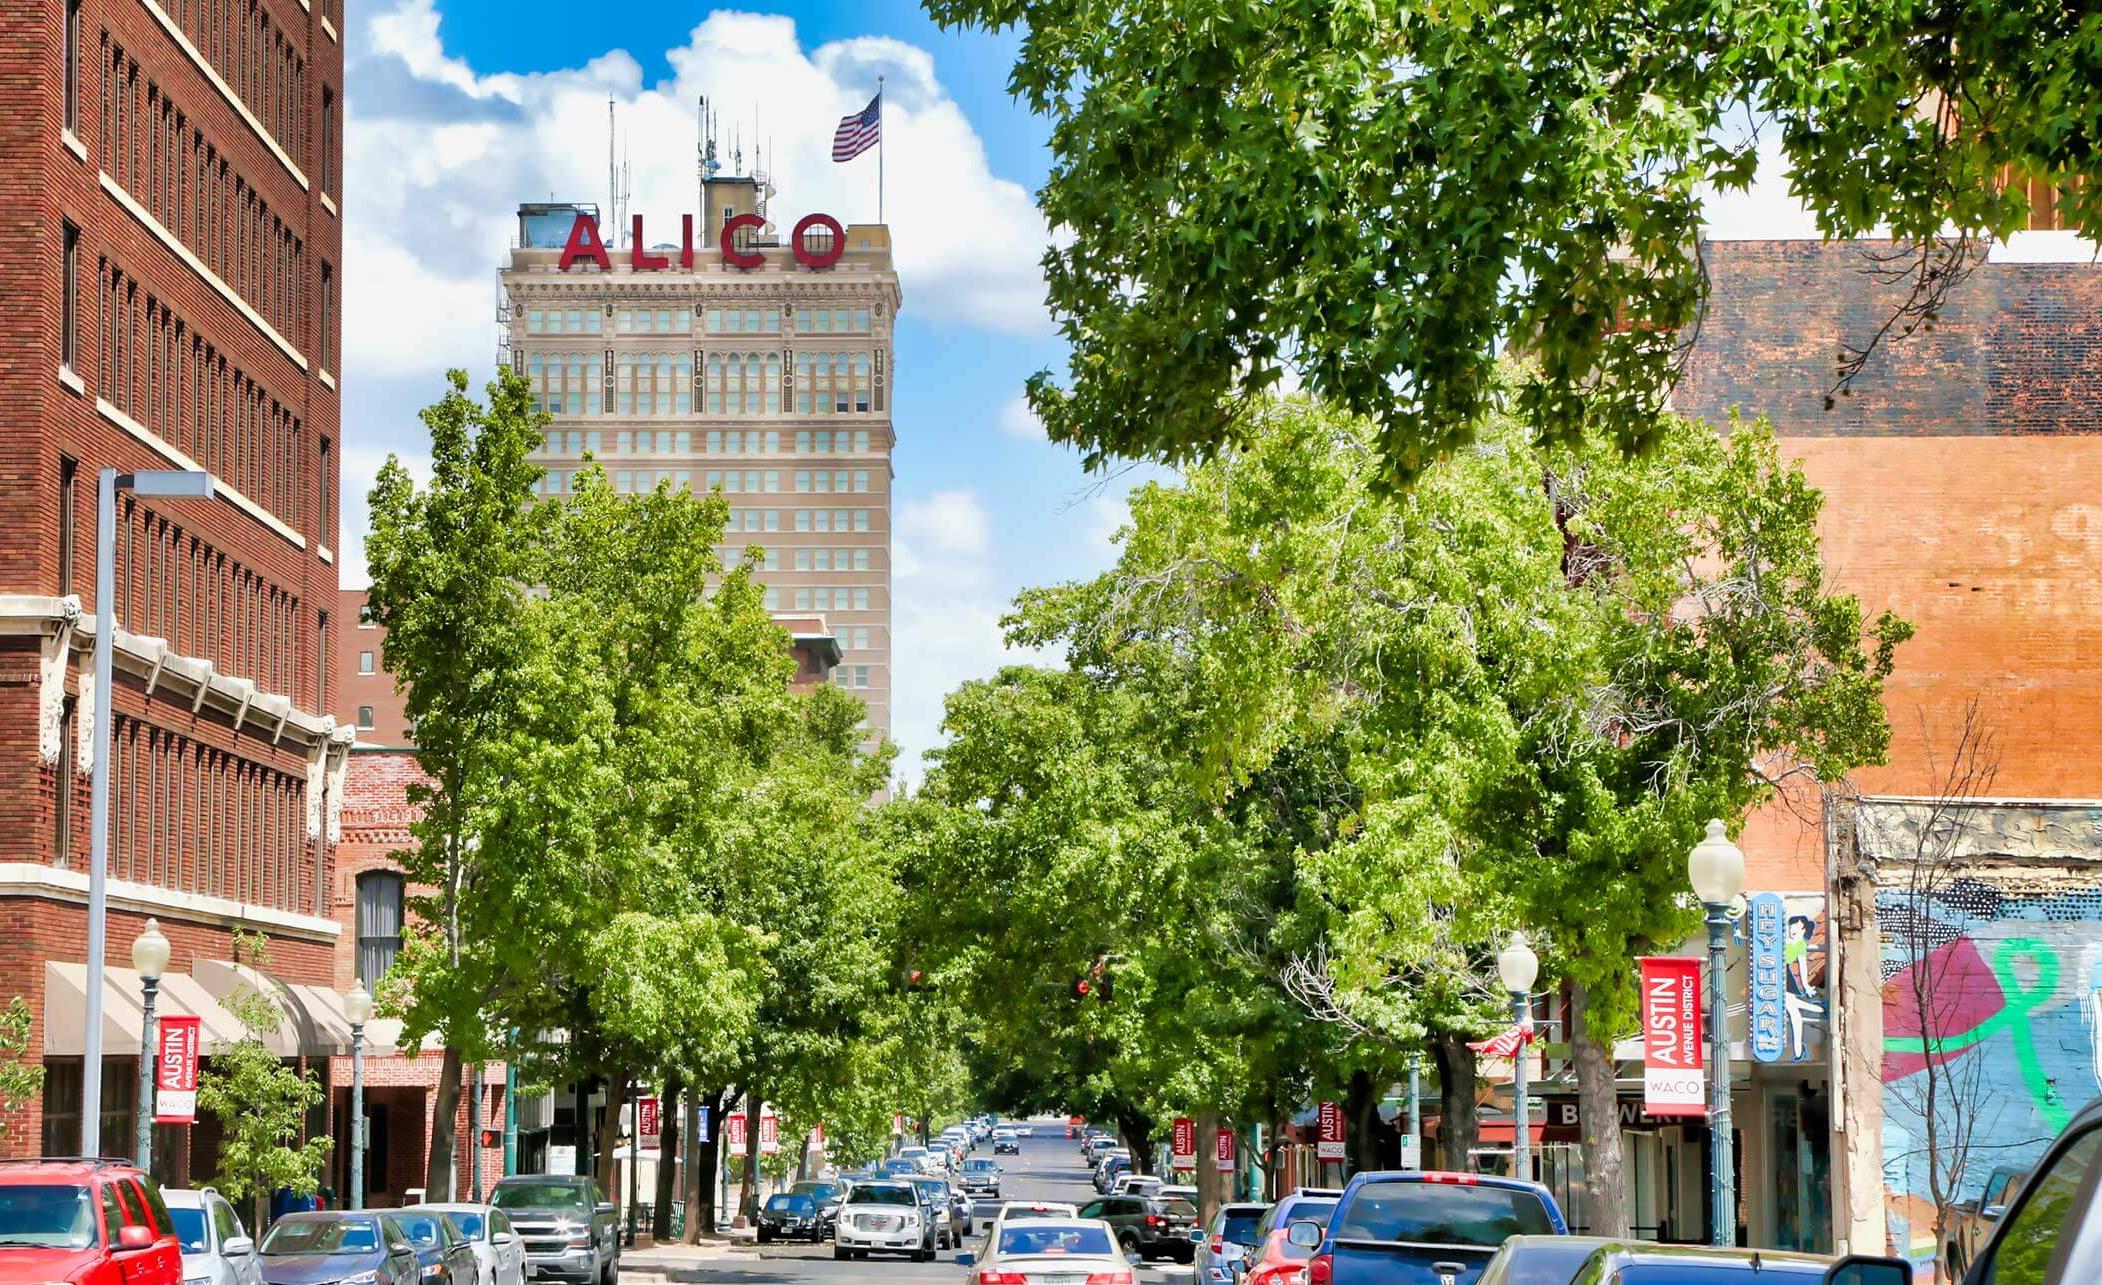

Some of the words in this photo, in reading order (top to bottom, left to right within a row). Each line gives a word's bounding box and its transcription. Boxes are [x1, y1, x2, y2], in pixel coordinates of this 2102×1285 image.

[558, 213, 845, 269] ALICO
[1758, 904, 1776, 949] HEY
[1682, 975, 1694, 1020] DISTRICT
[1758, 955, 1778, 1038] SUGAR
[187, 1026, 195, 1056] DISTRICT
[1650, 977, 1677, 1065] AUSTIN
[164, 1028, 184, 1088] AUSTIN
[1682, 1022, 1694, 1065] AVENUE
[185, 1059, 194, 1088] AVENUE
[1650, 1081, 1699, 1094] WACO
[641, 1104, 651, 1134] AUSTIN
[1176, 1124, 1185, 1154] AUSTIN
[1322, 1102, 1334, 1140] AUSTIN
